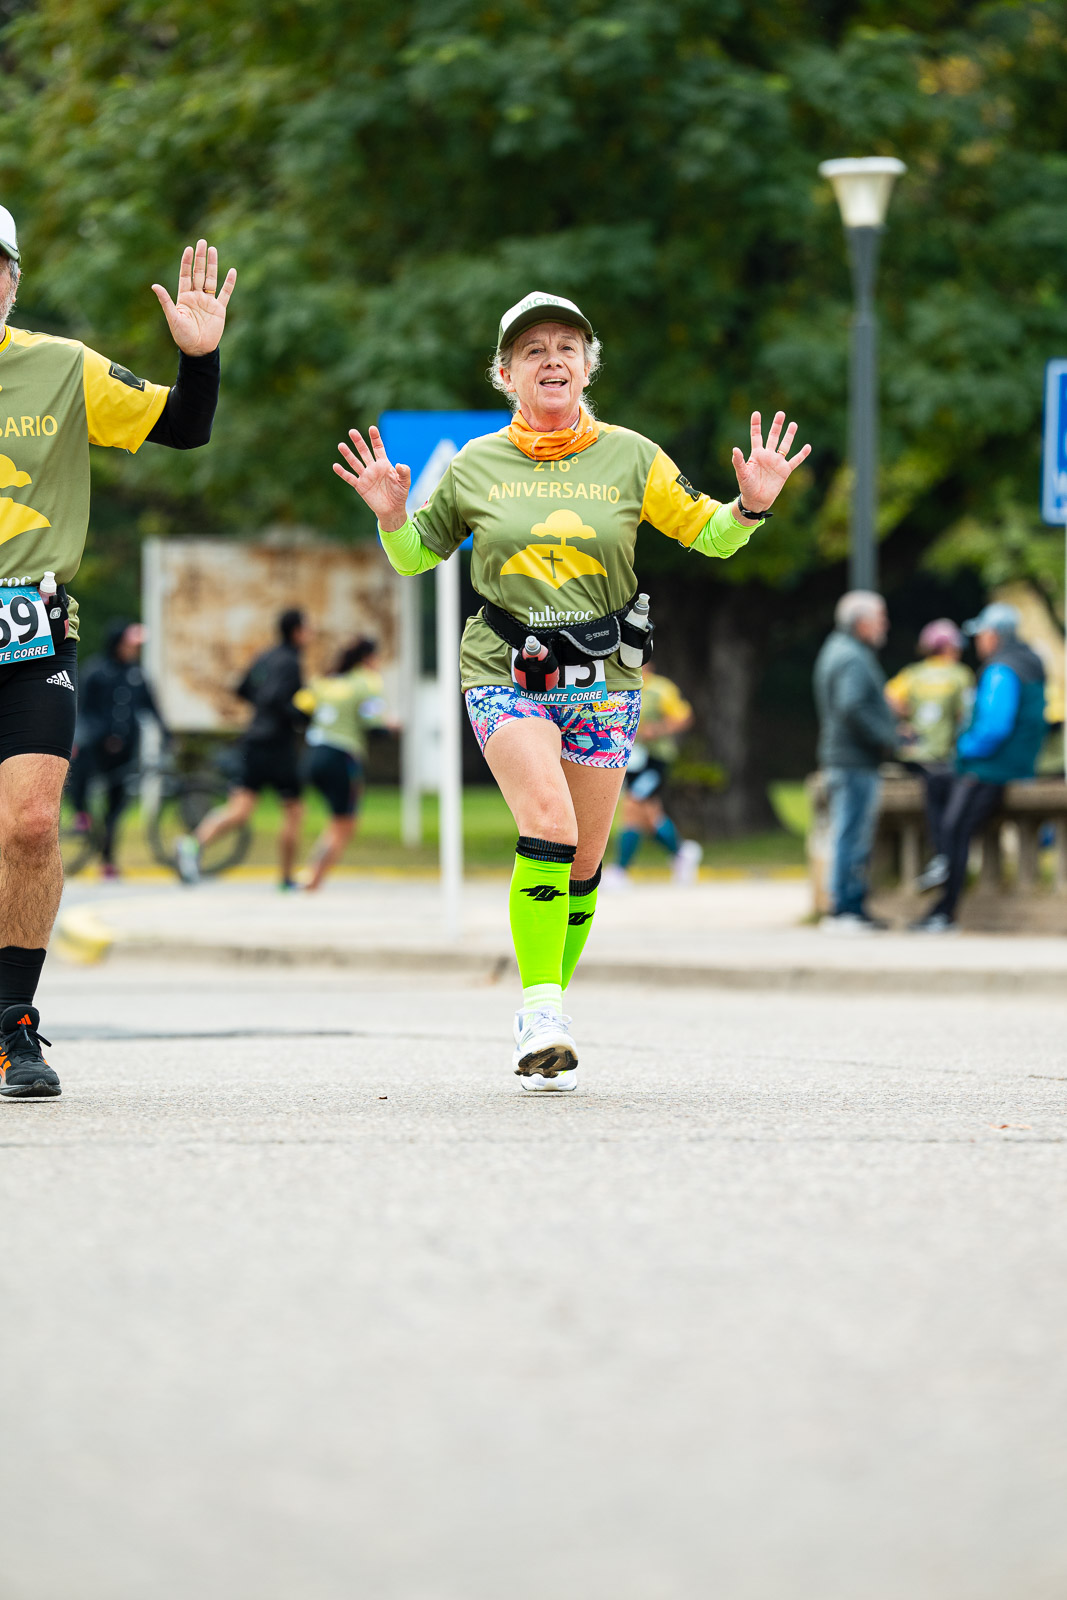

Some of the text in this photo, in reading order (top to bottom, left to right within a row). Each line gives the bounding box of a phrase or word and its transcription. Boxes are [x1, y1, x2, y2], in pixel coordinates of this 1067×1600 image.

[520, 297, 560, 311] MCM
[0, 414, 58, 437] ARIO
[488, 481, 621, 504] ANIVERSARIO
[527, 605, 594, 627] julicroc
[13, 645, 48, 659] CORRE
[46, 678, 75, 691] adidas
[520, 690, 603, 702] DIAMANTE CORRE
